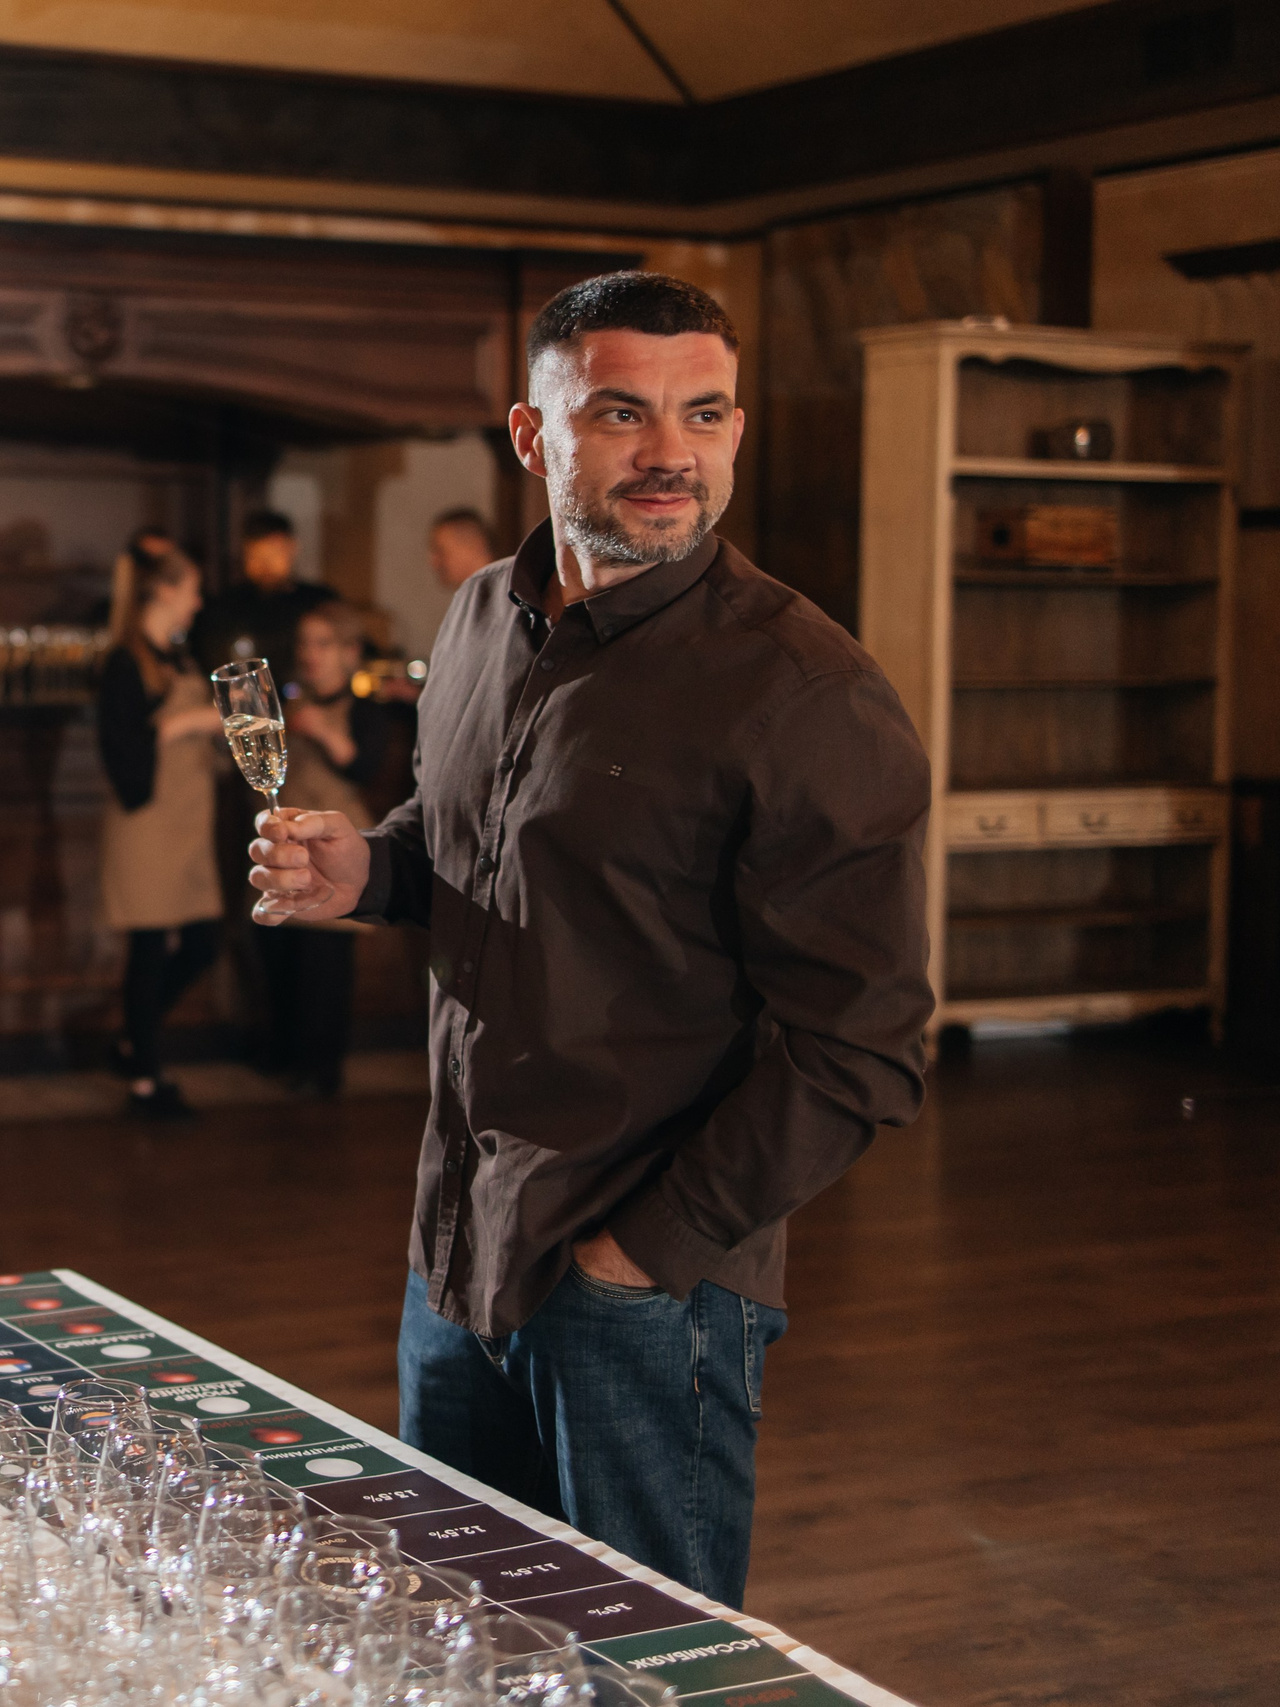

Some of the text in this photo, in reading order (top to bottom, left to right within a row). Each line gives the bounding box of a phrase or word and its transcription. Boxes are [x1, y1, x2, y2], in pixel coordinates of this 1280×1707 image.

[10, 1375, 54, 1385] США
[174, 1388, 239, 1402] ГРЮНЕР
[260, 1441, 370, 1462] ГЕВЮРЦТРАМИН
[362, 1489, 420, 1503] 13.5%
[427, 1524, 487, 1539] 12.5%
[500, 1562, 561, 1578] 11.5%
[587, 1602, 634, 1616] 10%
[626, 1637, 761, 1670] АССАМБЛЯЖ
